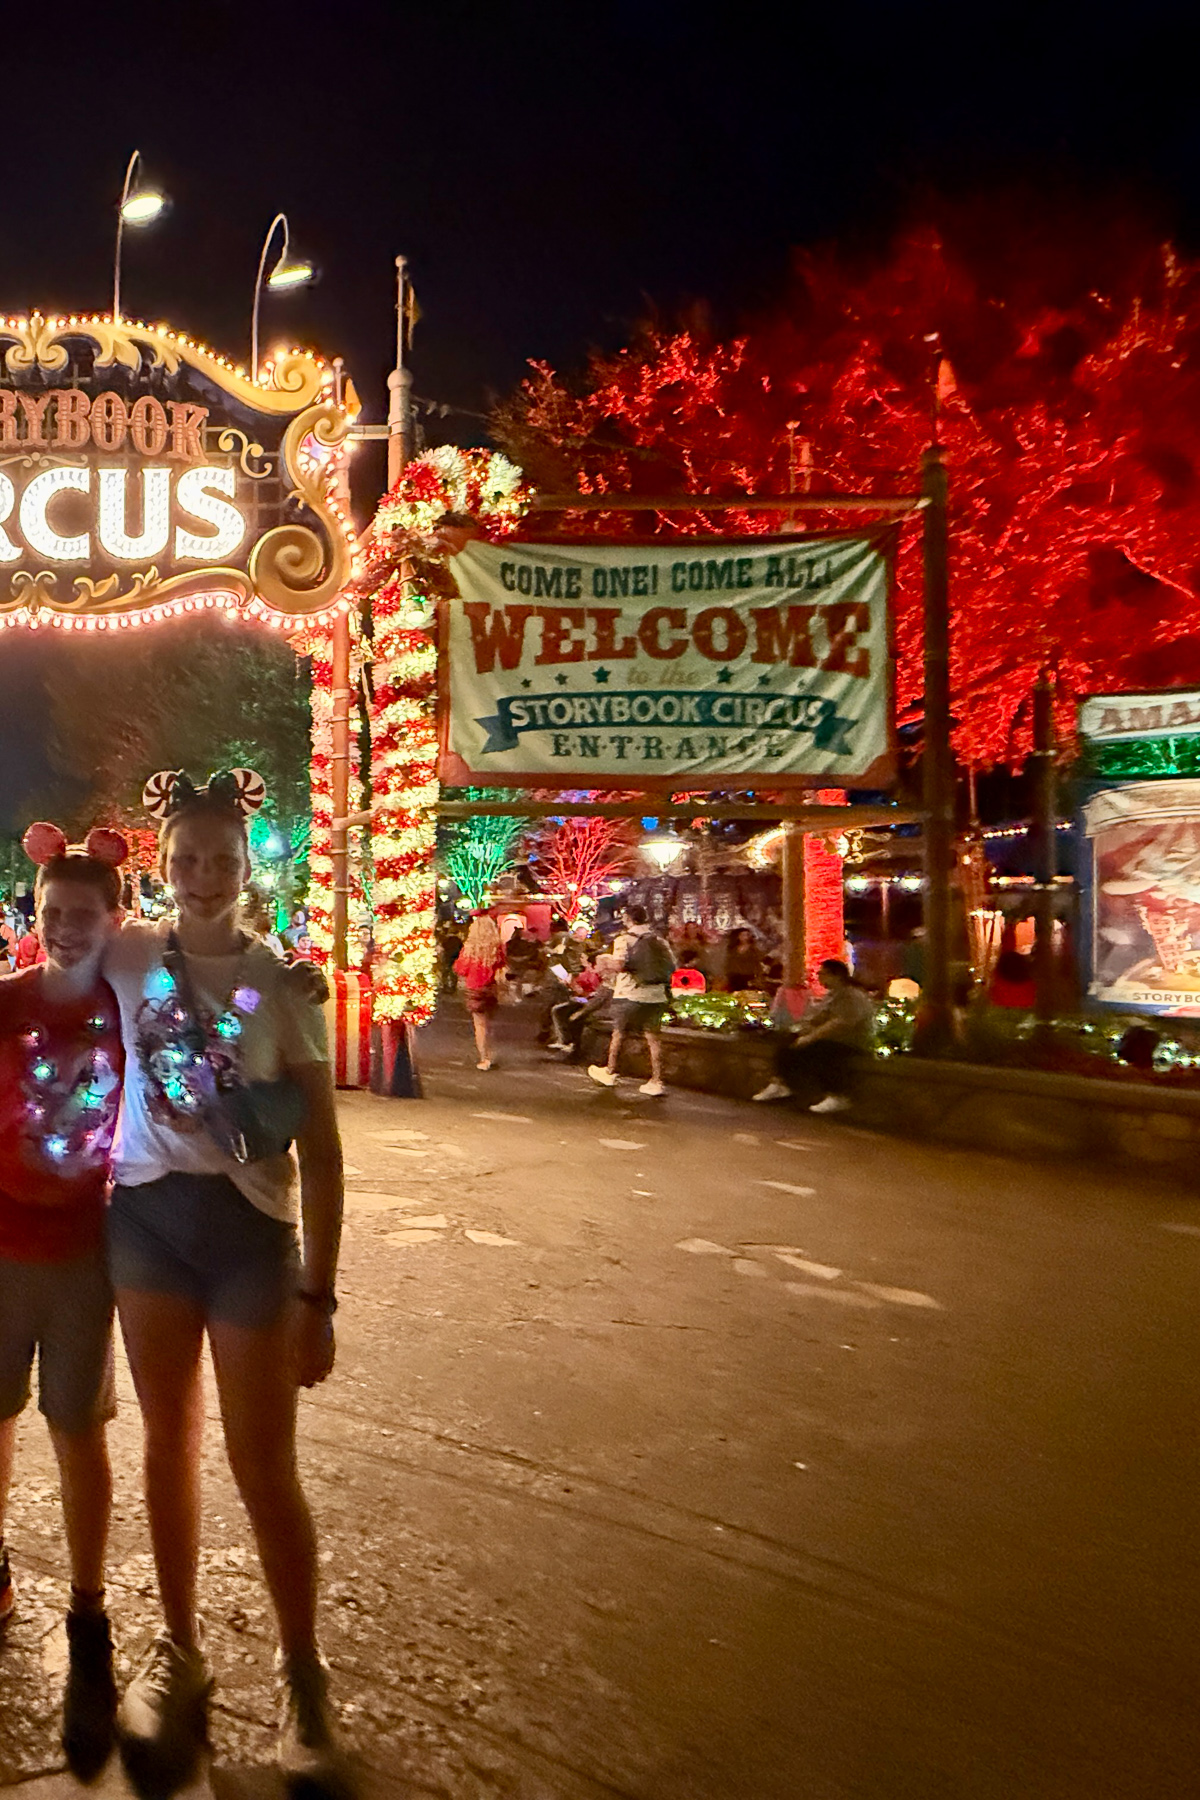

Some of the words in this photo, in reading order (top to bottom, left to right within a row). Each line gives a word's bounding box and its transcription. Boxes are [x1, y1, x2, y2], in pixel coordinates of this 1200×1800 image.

[501, 561, 582, 598] COME
[592, 563, 658, 598] ONE!
[671, 559, 753, 592] COME
[764, 557, 834, 590] ALL!
[463, 600, 871, 679] WELCOME
[627, 665, 650, 685] to
[660, 660, 700, 685] the
[510, 696, 701, 727] STORYBOOK
[711, 697, 825, 728] CIRCUS
[1100, 701, 1200, 733] AMA
